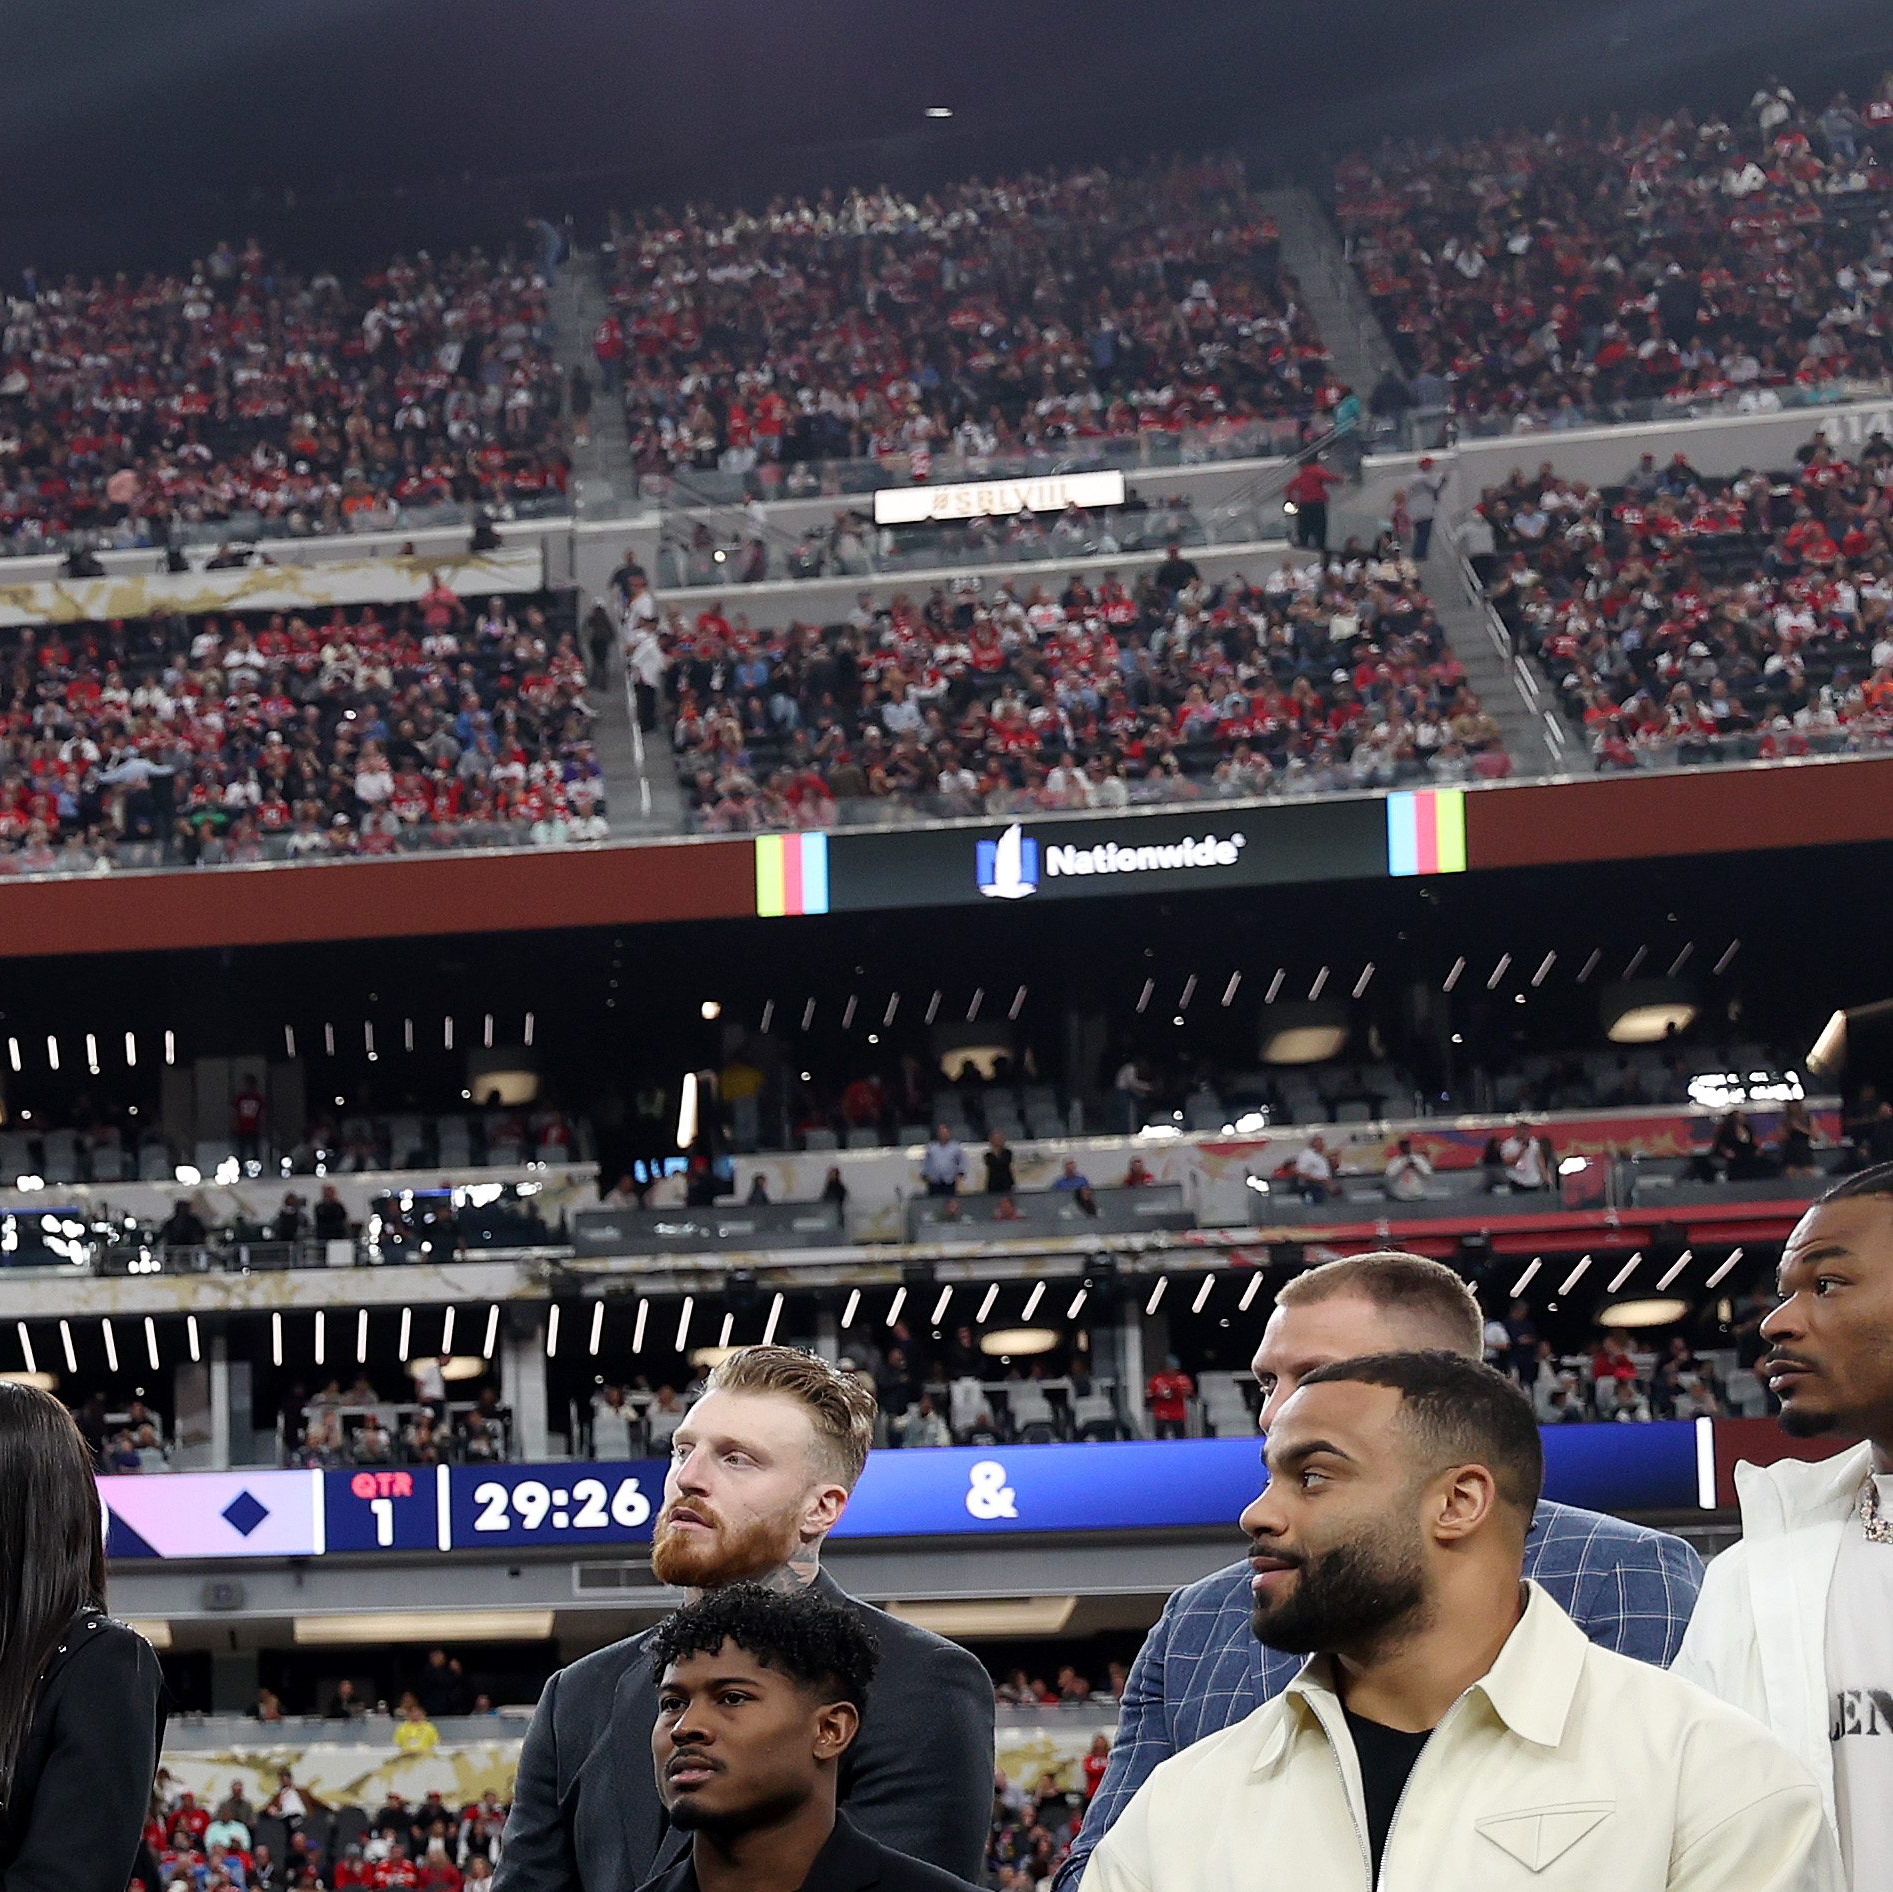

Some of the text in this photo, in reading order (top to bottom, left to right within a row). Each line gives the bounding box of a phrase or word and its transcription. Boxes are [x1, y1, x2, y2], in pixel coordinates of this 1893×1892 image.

[351, 1471, 413, 1500] QTR
[473, 1477, 651, 1532] 29:26
[965, 1460, 1020, 1519] &
[370, 1498, 394, 1547] 1
